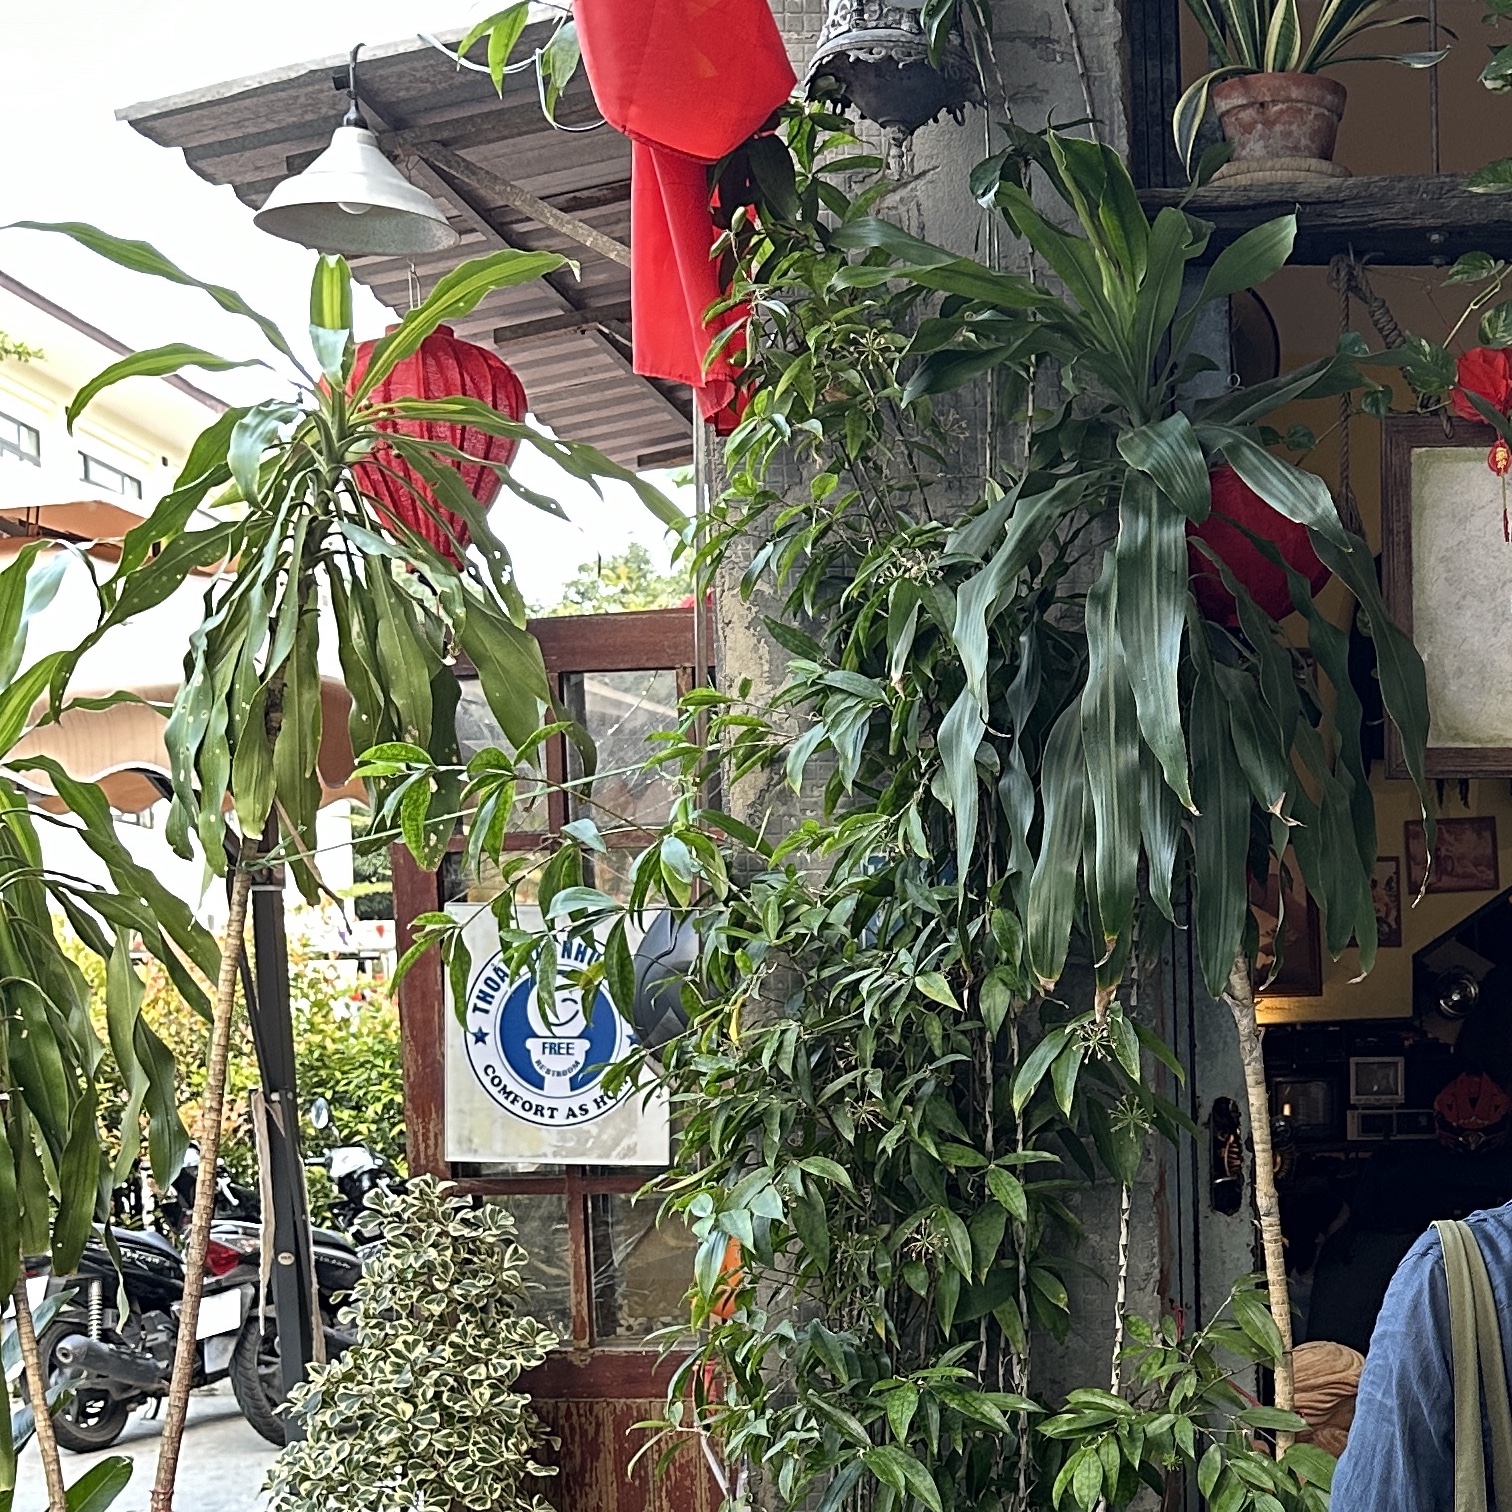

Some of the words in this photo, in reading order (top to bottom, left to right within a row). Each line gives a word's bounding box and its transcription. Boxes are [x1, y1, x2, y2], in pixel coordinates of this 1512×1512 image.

[542, 1041, 575, 1056] FREE
[535, 1058, 581, 1077] RESTROOM
[484, 1064, 559, 1119] COMFORT
[565, 1103, 590, 1120] AS
